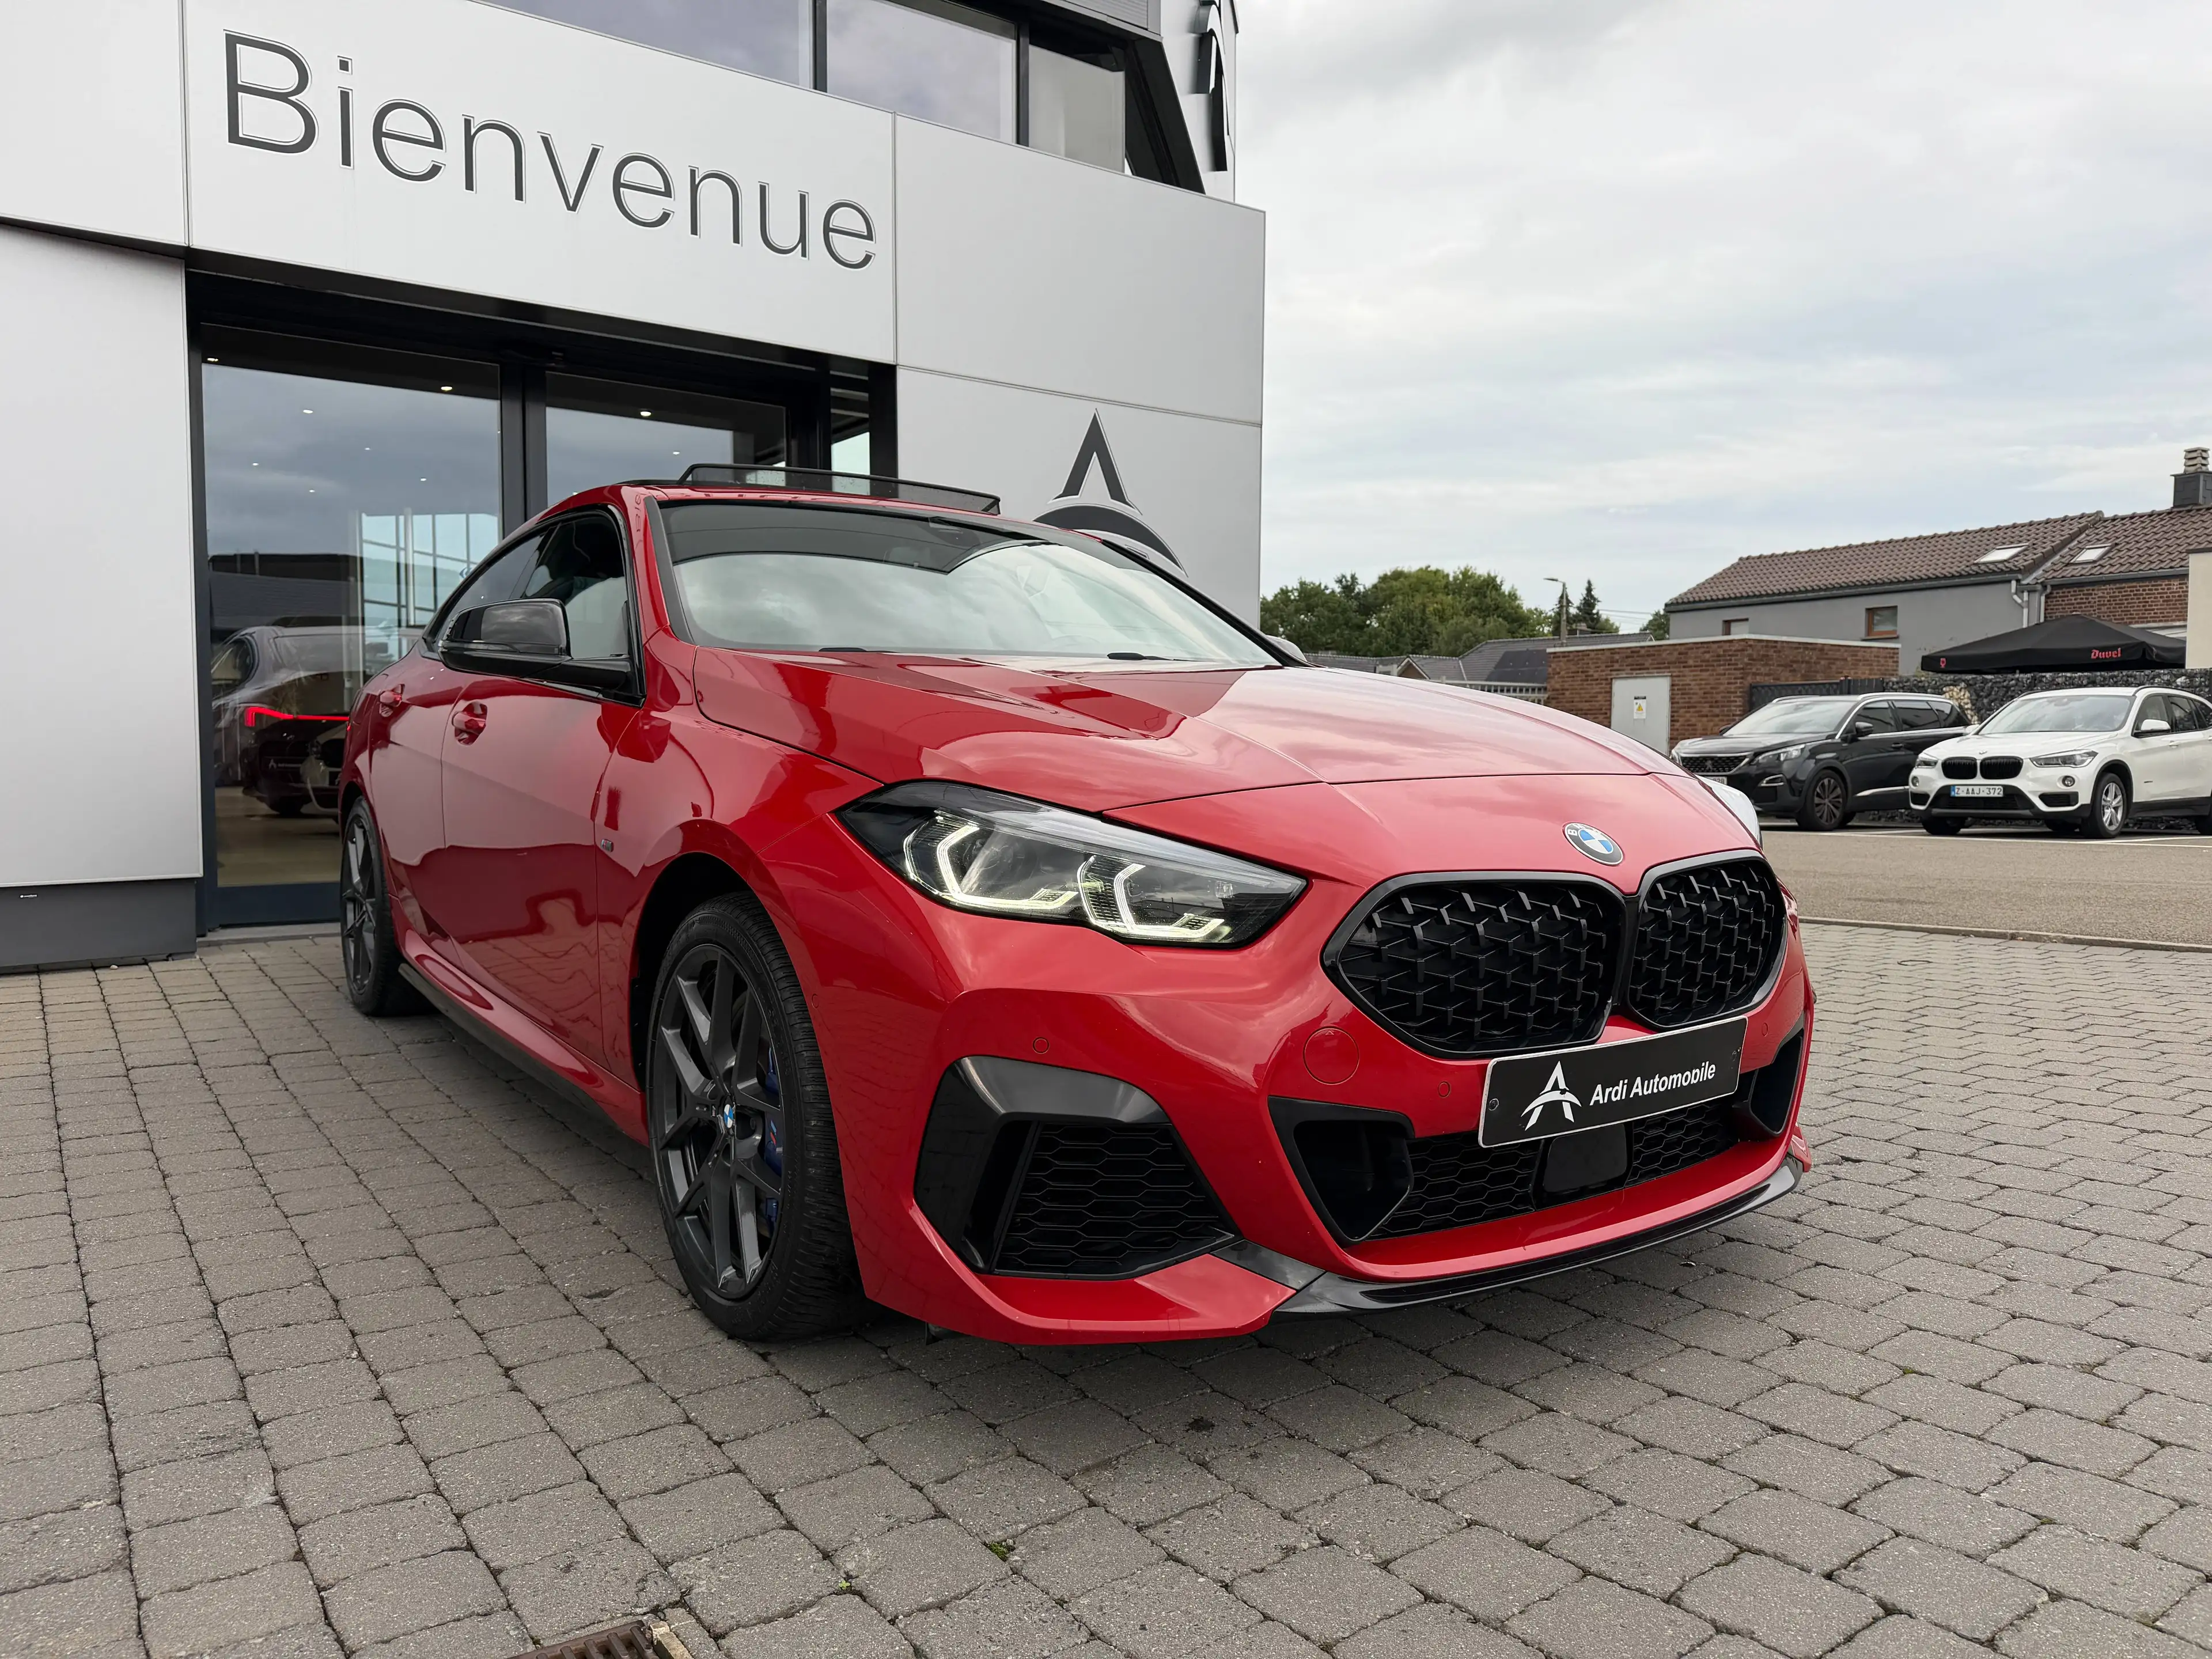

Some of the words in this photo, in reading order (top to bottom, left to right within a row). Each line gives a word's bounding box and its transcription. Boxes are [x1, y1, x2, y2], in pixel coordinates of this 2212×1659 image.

[224, 29, 877, 270] Bienvenue
[2091, 647, 2122, 659] Duvel
[1589, 1079, 1628, 1106] Ardi
[1630, 1060, 1716, 1098] Automobile
